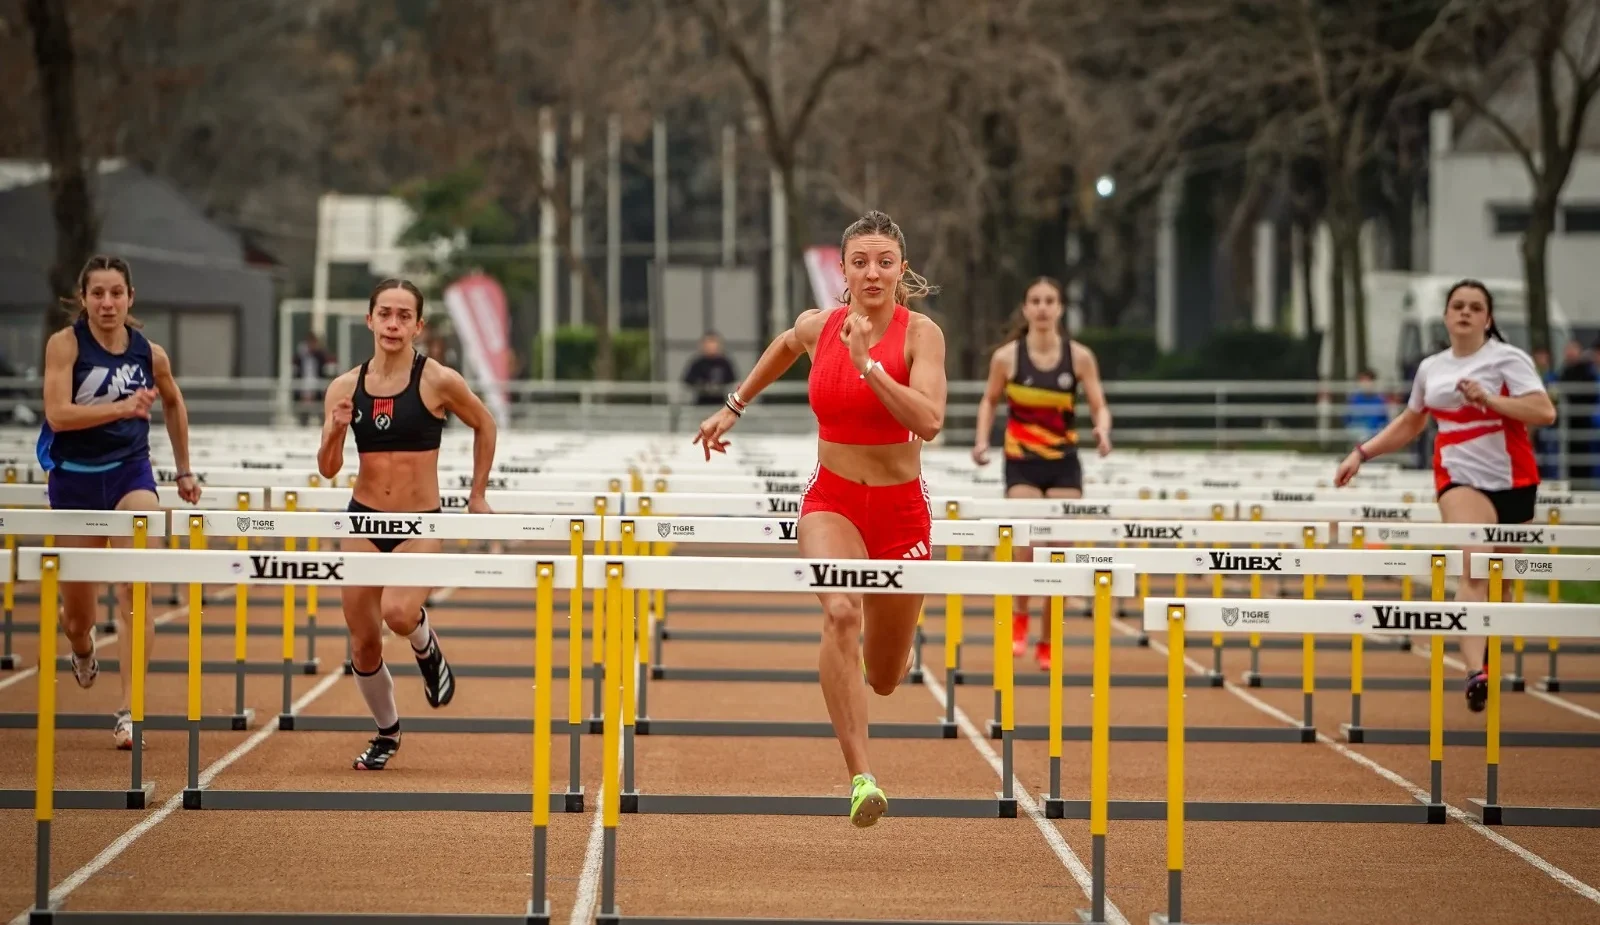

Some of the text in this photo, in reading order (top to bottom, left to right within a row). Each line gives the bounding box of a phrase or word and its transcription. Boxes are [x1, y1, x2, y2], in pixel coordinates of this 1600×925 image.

[768, 498, 798, 512] Vin
[1362, 506, 1411, 520] Vinex
[348, 516, 422, 535] Vinex
[1123, 524, 1182, 539] Vinex
[1483, 528, 1544, 544] Vinex
[250, 556, 344, 580] Vinex
[1208, 552, 1282, 570] Vinex
[810, 564, 903, 588] Vinex
[1372, 606, 1468, 630] Vinex
